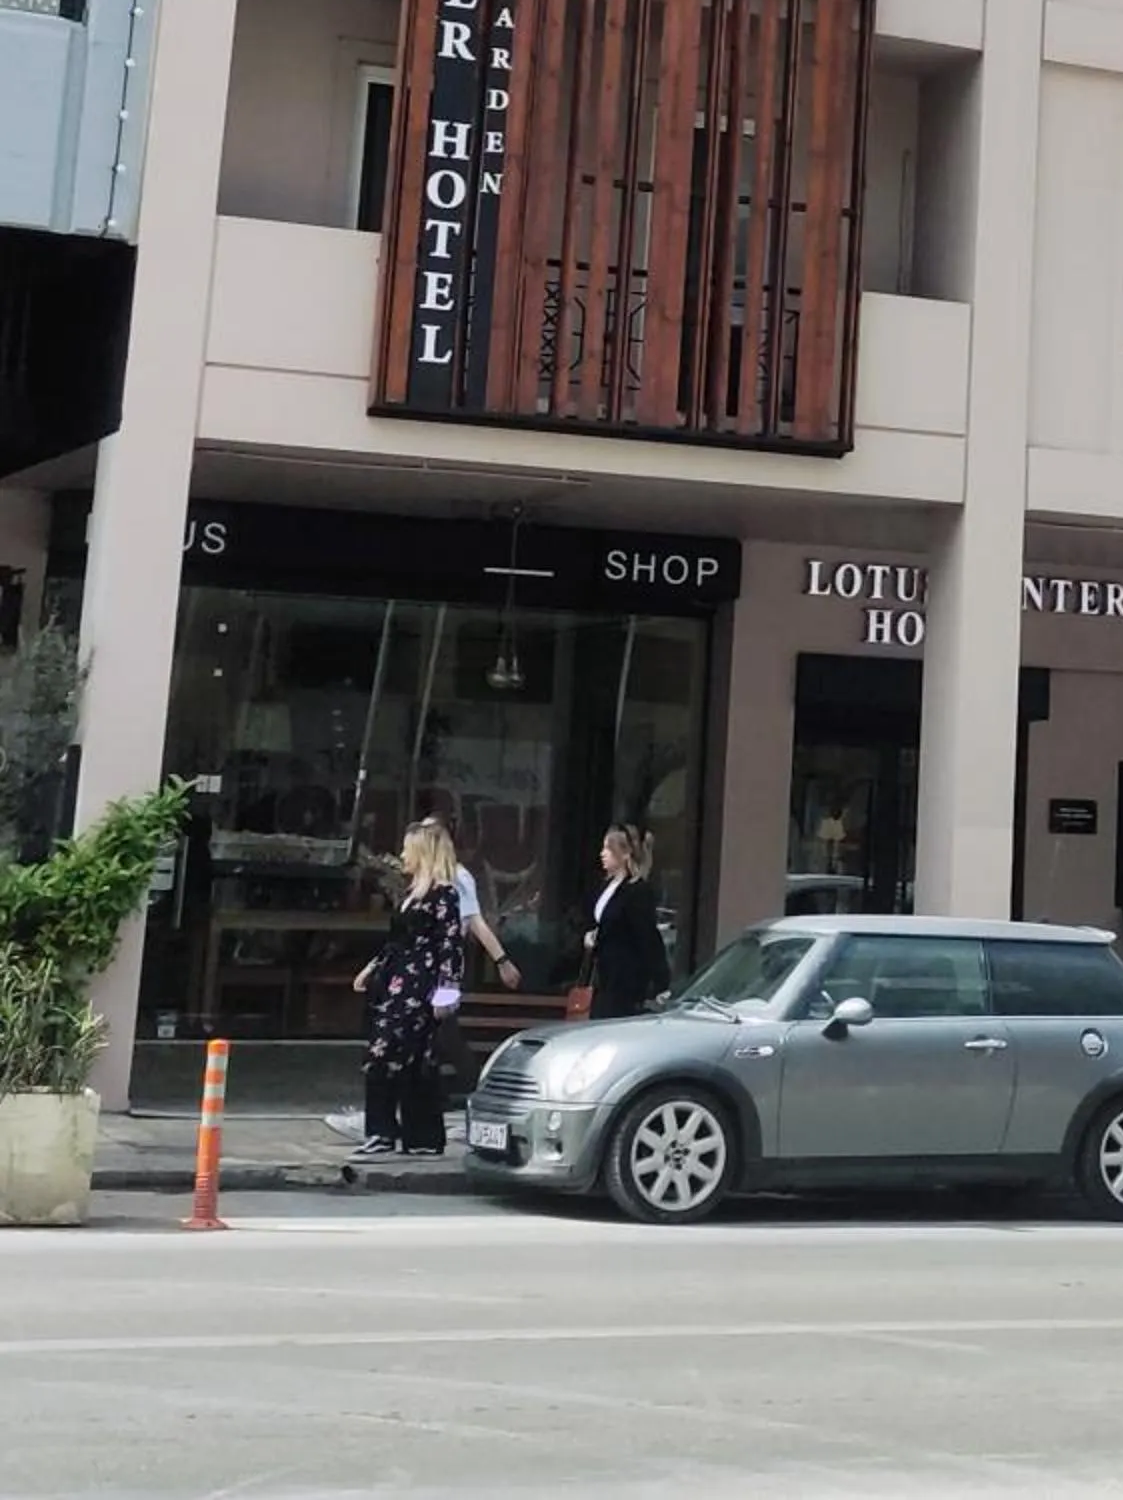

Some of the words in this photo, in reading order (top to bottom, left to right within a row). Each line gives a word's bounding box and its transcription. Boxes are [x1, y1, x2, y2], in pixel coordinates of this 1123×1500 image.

[417, 119, 471, 364] HOTEL
[604, 550, 719, 587] SHOP
[807, 560, 928, 602] LOTU
